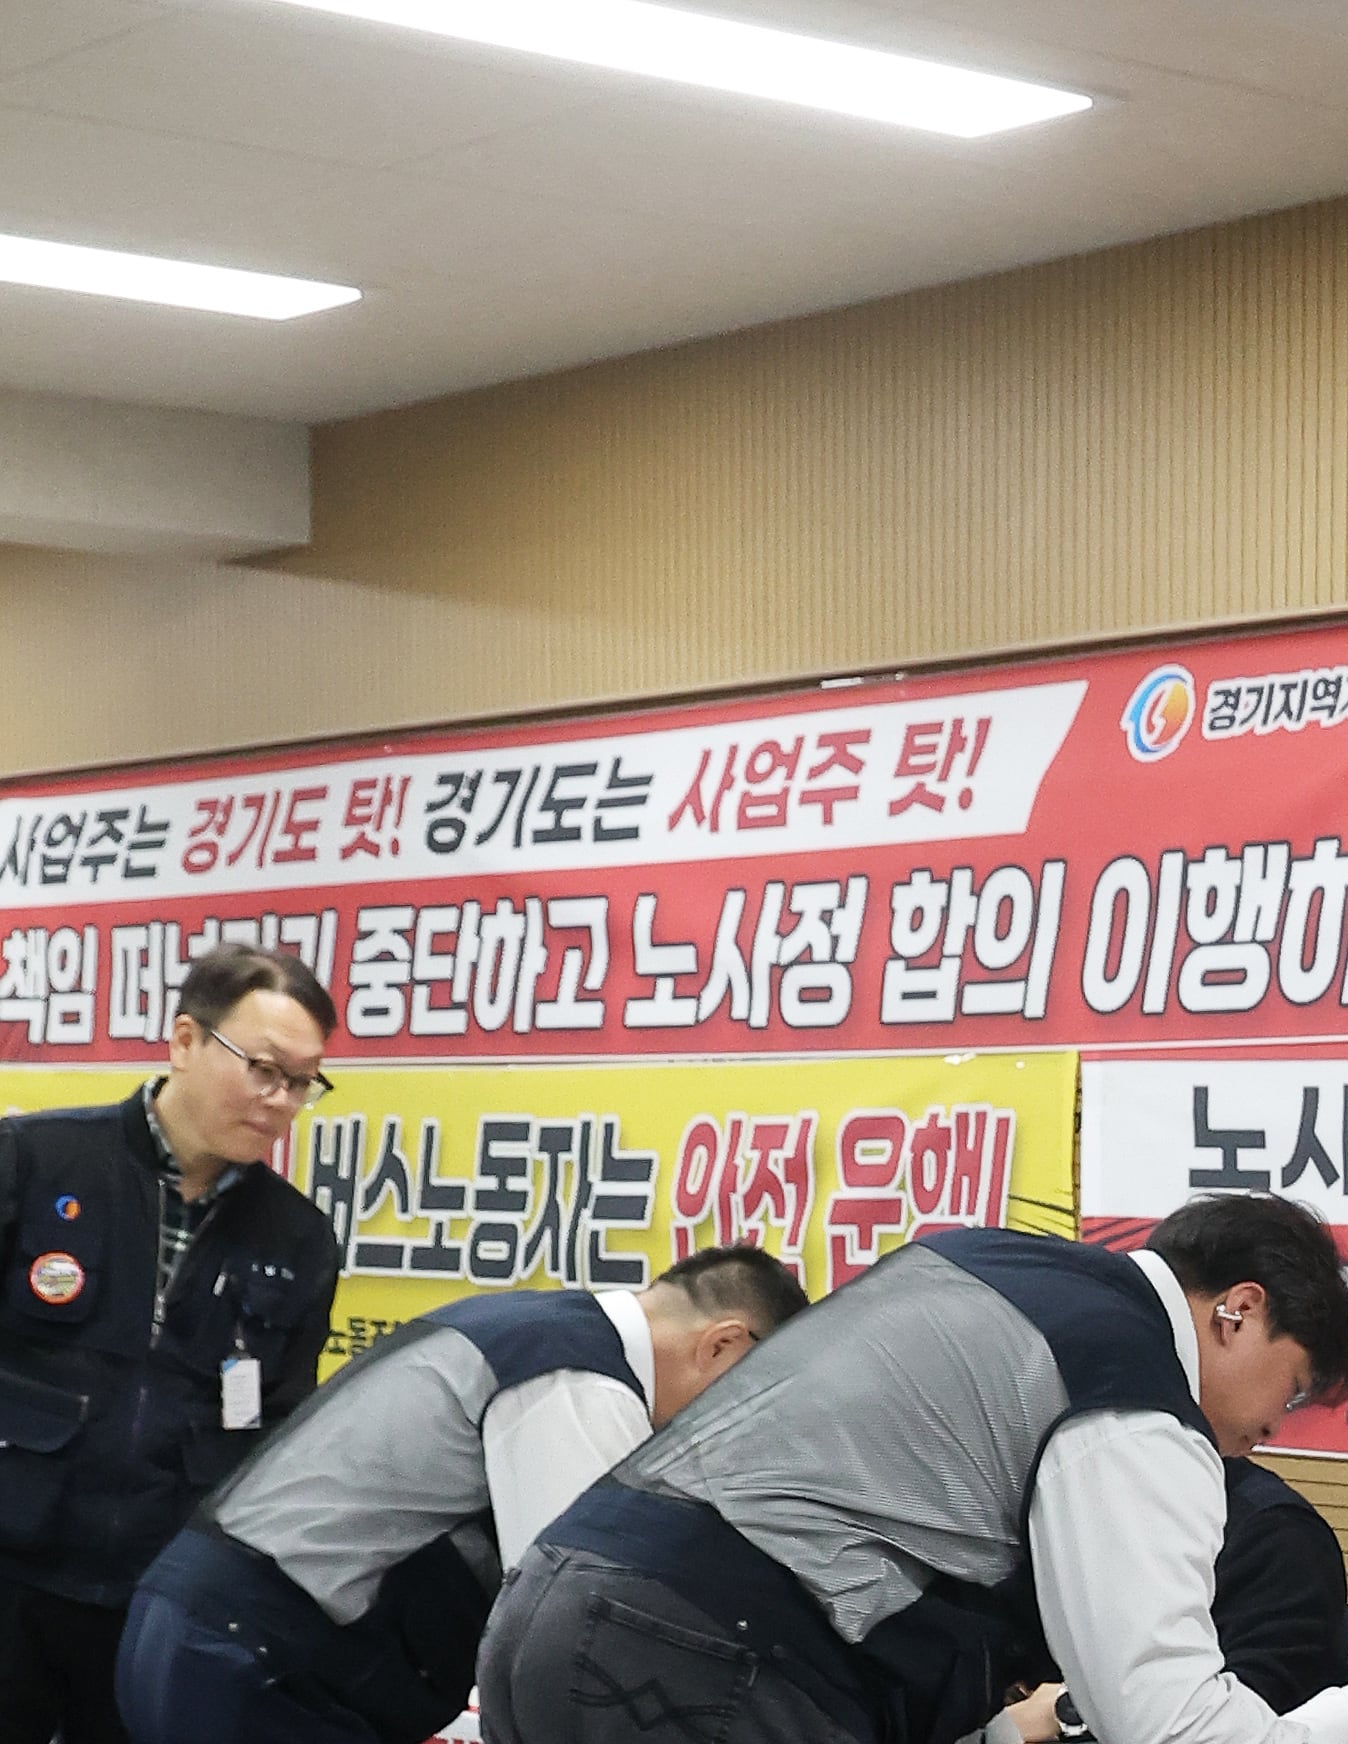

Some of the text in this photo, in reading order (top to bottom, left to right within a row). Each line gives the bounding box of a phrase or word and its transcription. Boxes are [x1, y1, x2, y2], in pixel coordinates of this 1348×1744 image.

[0, 715, 991, 887] 사업주는 경기도 탓! 경기도는 사업주 탓!
[0, 923, 98, 1044] 책임
[345, 893, 611, 1040] 중단하고
[624, 872, 871, 1031] 노사정
[880, 859, 1068, 1025] 합의
[311, 1118, 655, 1286] 버스노동자는
